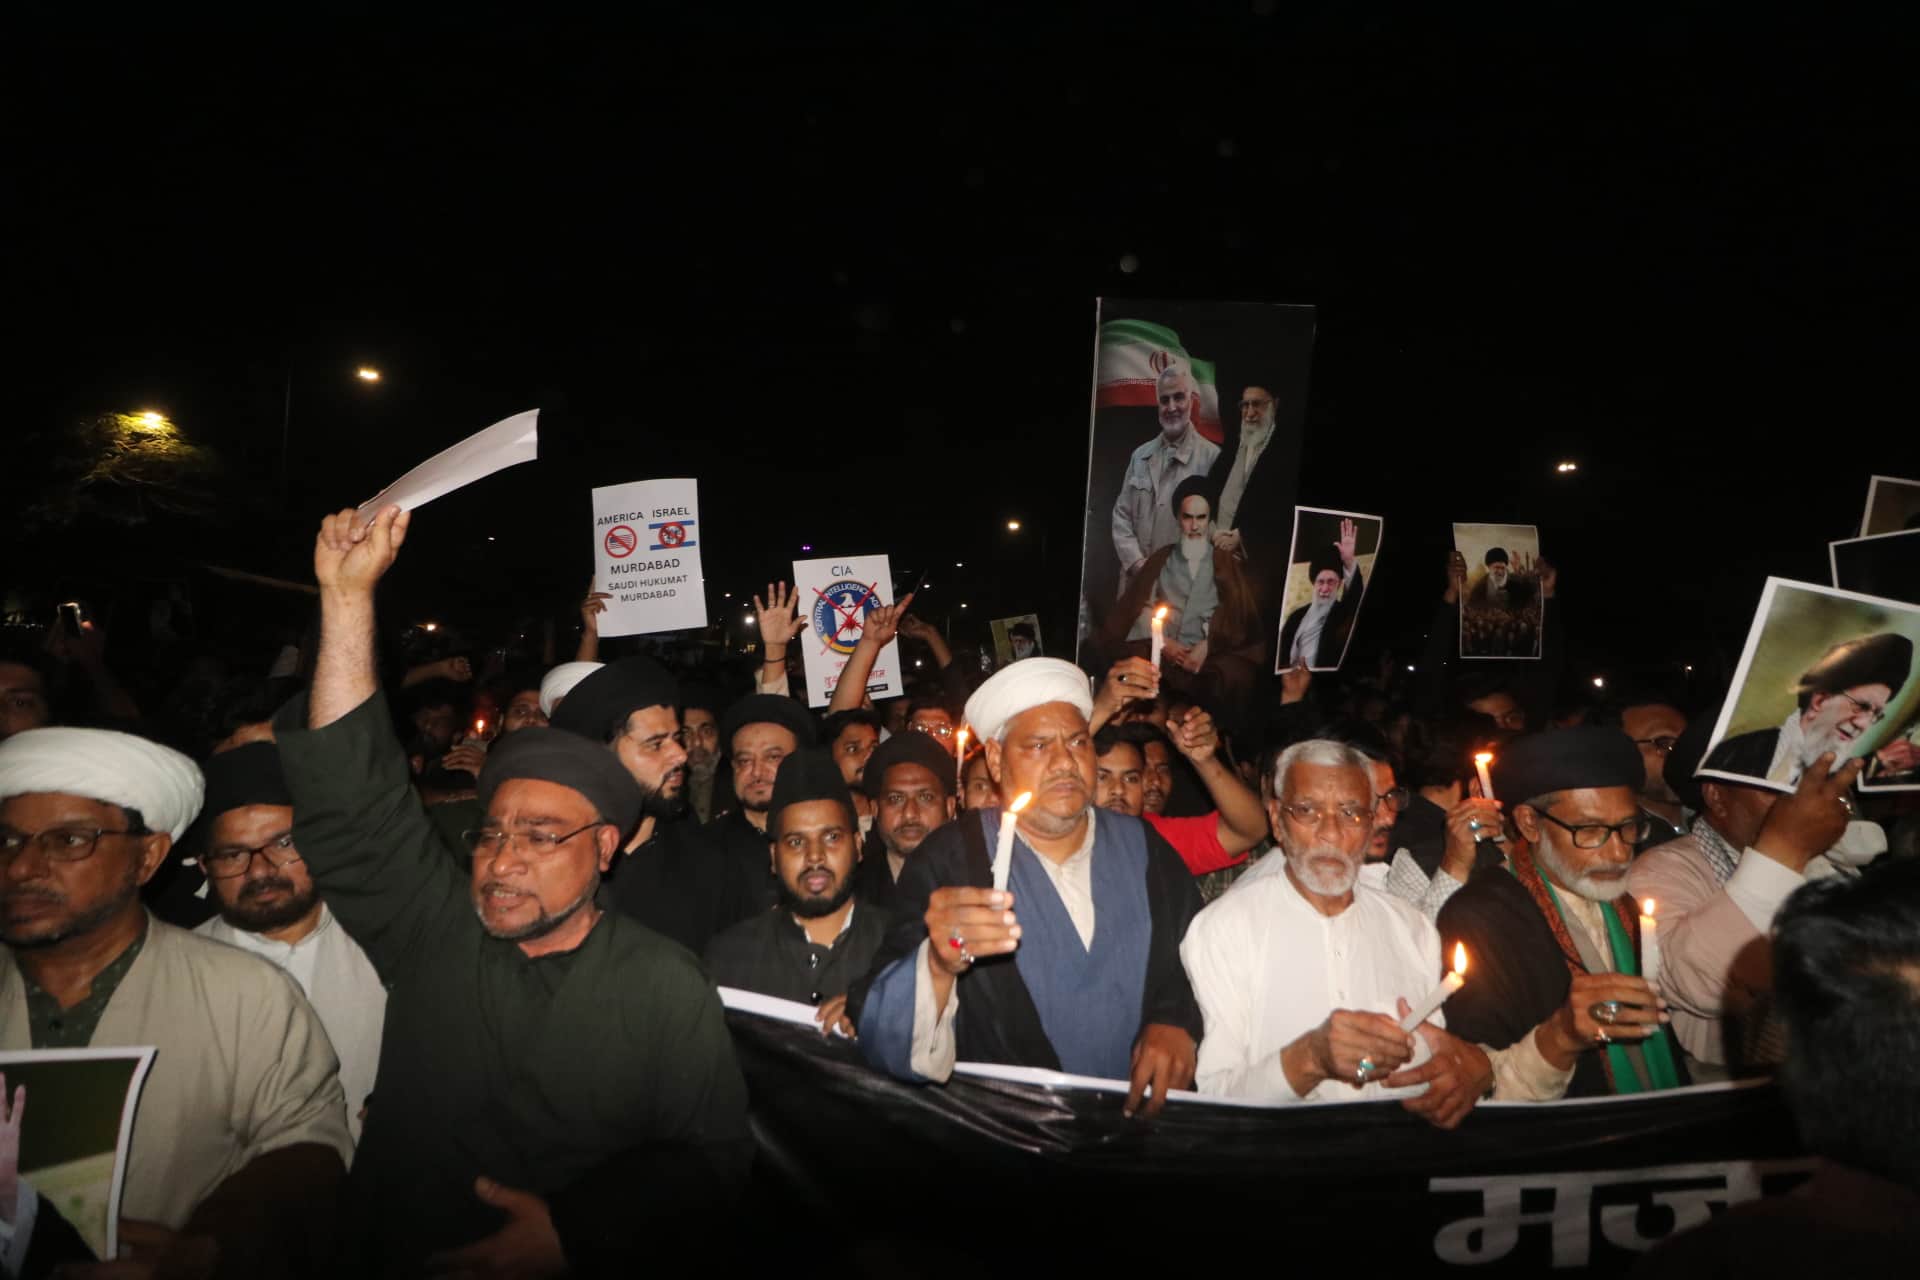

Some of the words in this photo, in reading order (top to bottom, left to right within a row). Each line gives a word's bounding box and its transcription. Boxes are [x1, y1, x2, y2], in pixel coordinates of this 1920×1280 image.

[597, 511, 644, 526] AMERICA
[652, 507, 690, 518] ISRAEL
[610, 558, 681, 575] MURDABAD
[831, 565, 854, 577] CIA
[608, 580, 638, 590] SAUDI
[640, 574, 688, 588] HUKUMAT
[620, 588, 676, 602] MURDABAD
[1428, 1157, 1826, 1269] मज
